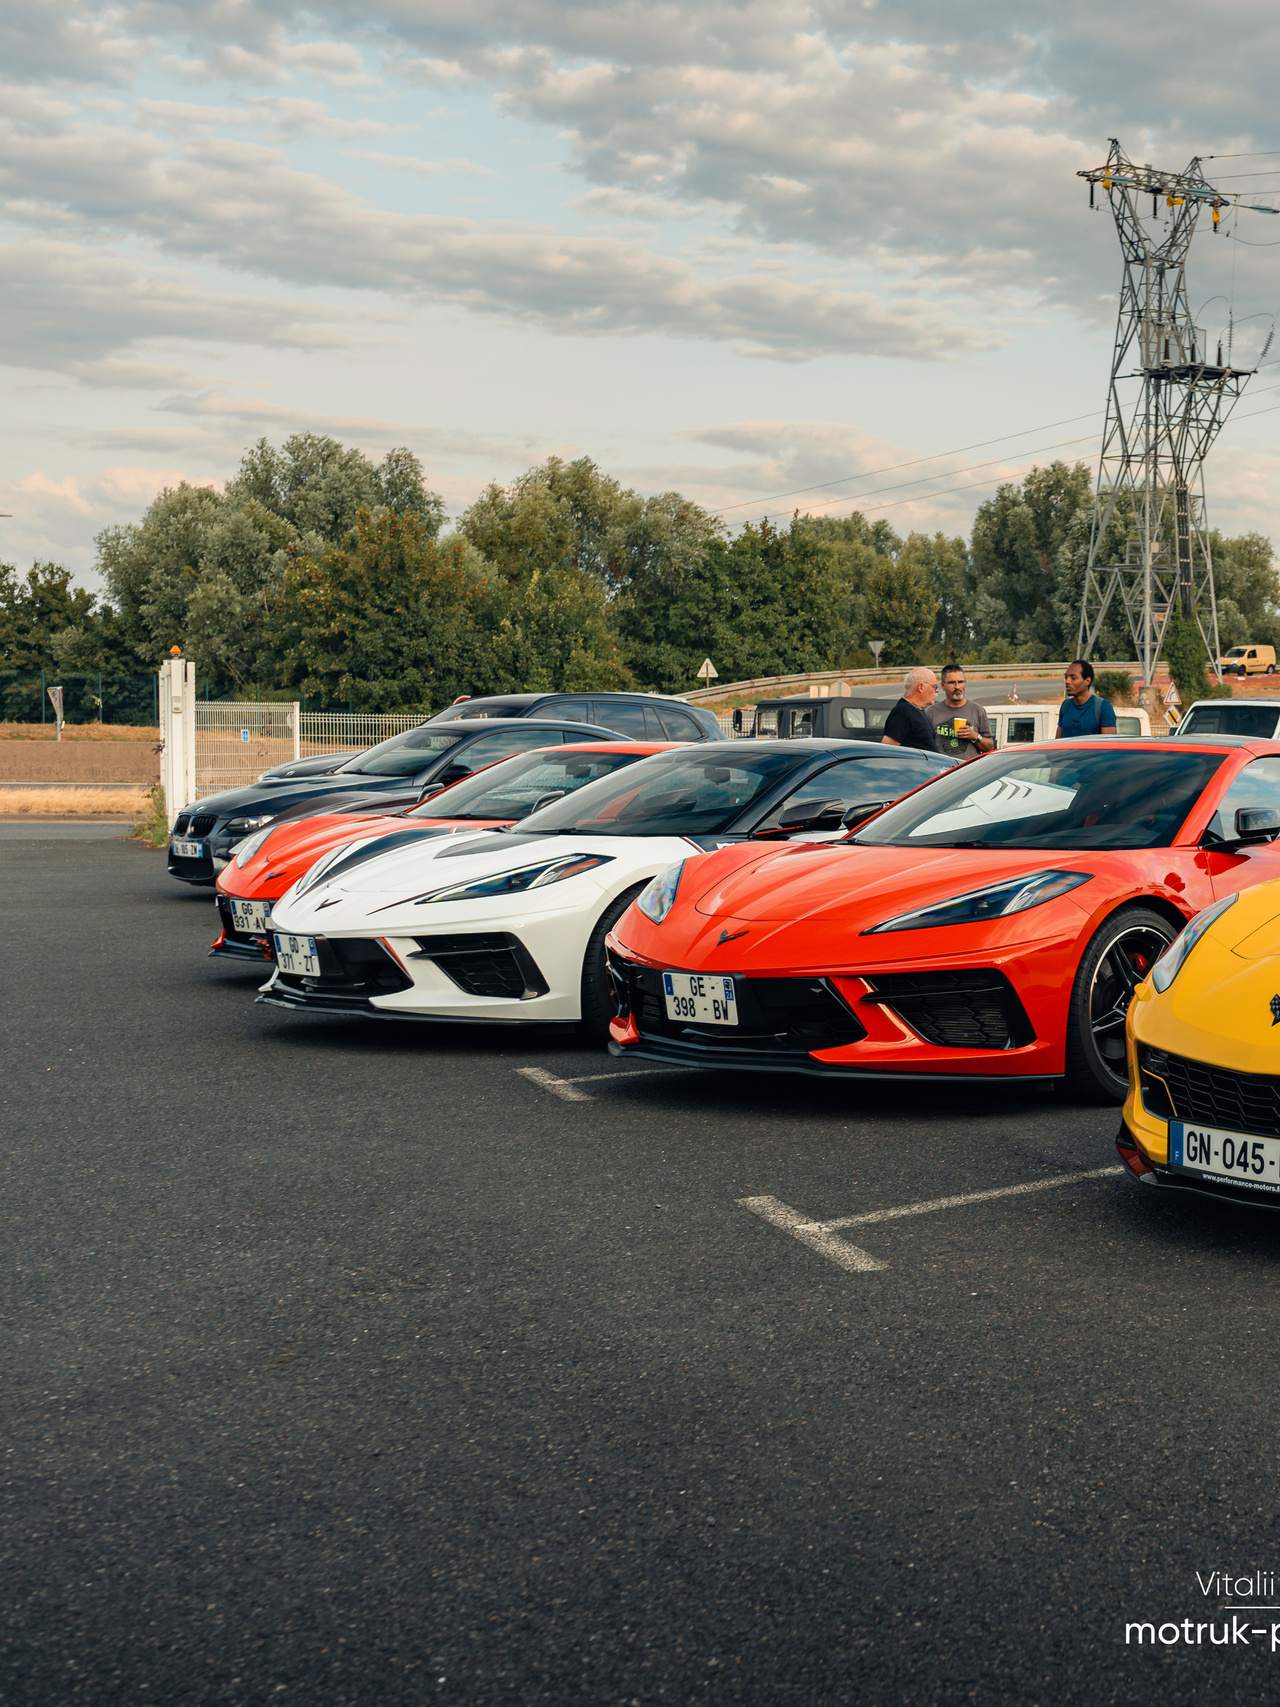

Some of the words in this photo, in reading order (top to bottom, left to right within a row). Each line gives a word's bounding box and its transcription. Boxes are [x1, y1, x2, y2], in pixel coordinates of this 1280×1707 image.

[936, 726, 948, 736] GAS
[241, 902, 253, 915] GG
[234, 915, 250, 929] 931
[281, 952, 295, 970] 371
[304, 955, 314, 972] ZT
[689, 976, 706, 997] GE
[673, 996, 696, 1018] 398
[712, 999, 729, 1021] BV
[1174, 1150, 1180, 1161] F
